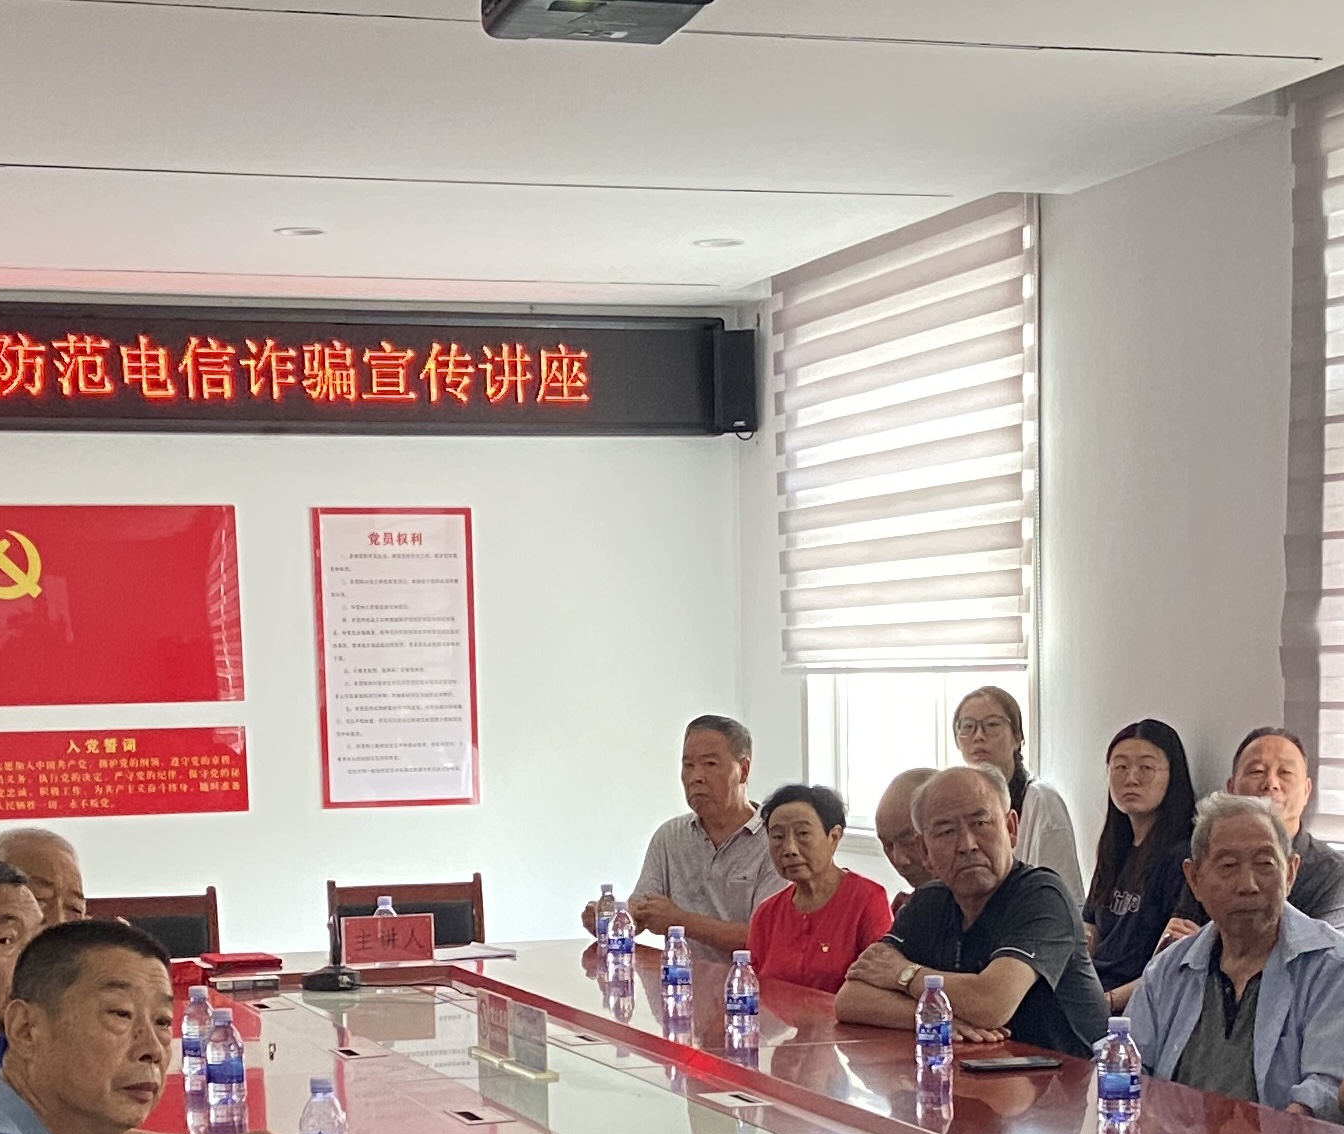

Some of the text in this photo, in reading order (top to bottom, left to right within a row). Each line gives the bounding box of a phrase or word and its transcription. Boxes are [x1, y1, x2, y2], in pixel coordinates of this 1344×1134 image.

[367, 531, 424, 547] 党员权利
[67, 738, 137, 754] 入党誓词
[355, 927, 425, 951] 主讲人
